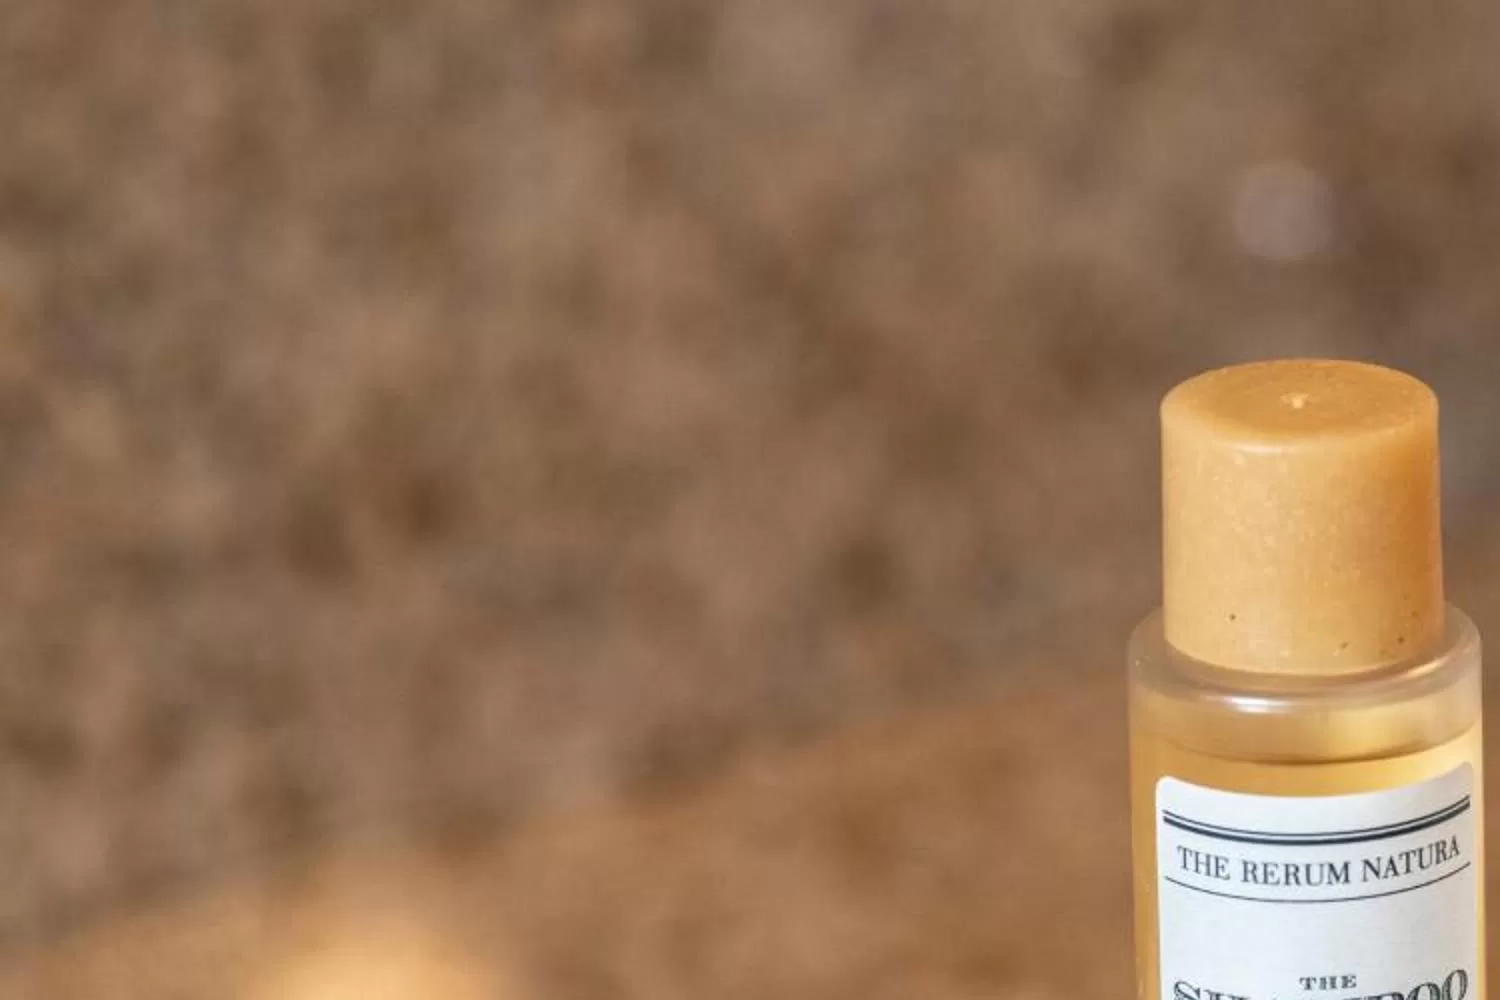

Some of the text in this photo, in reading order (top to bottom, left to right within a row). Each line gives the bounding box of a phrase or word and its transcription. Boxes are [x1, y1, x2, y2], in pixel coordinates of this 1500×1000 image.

[1176, 835, 1461, 887] THE RERUM NATURA
[1299, 974, 1357, 991] THE
